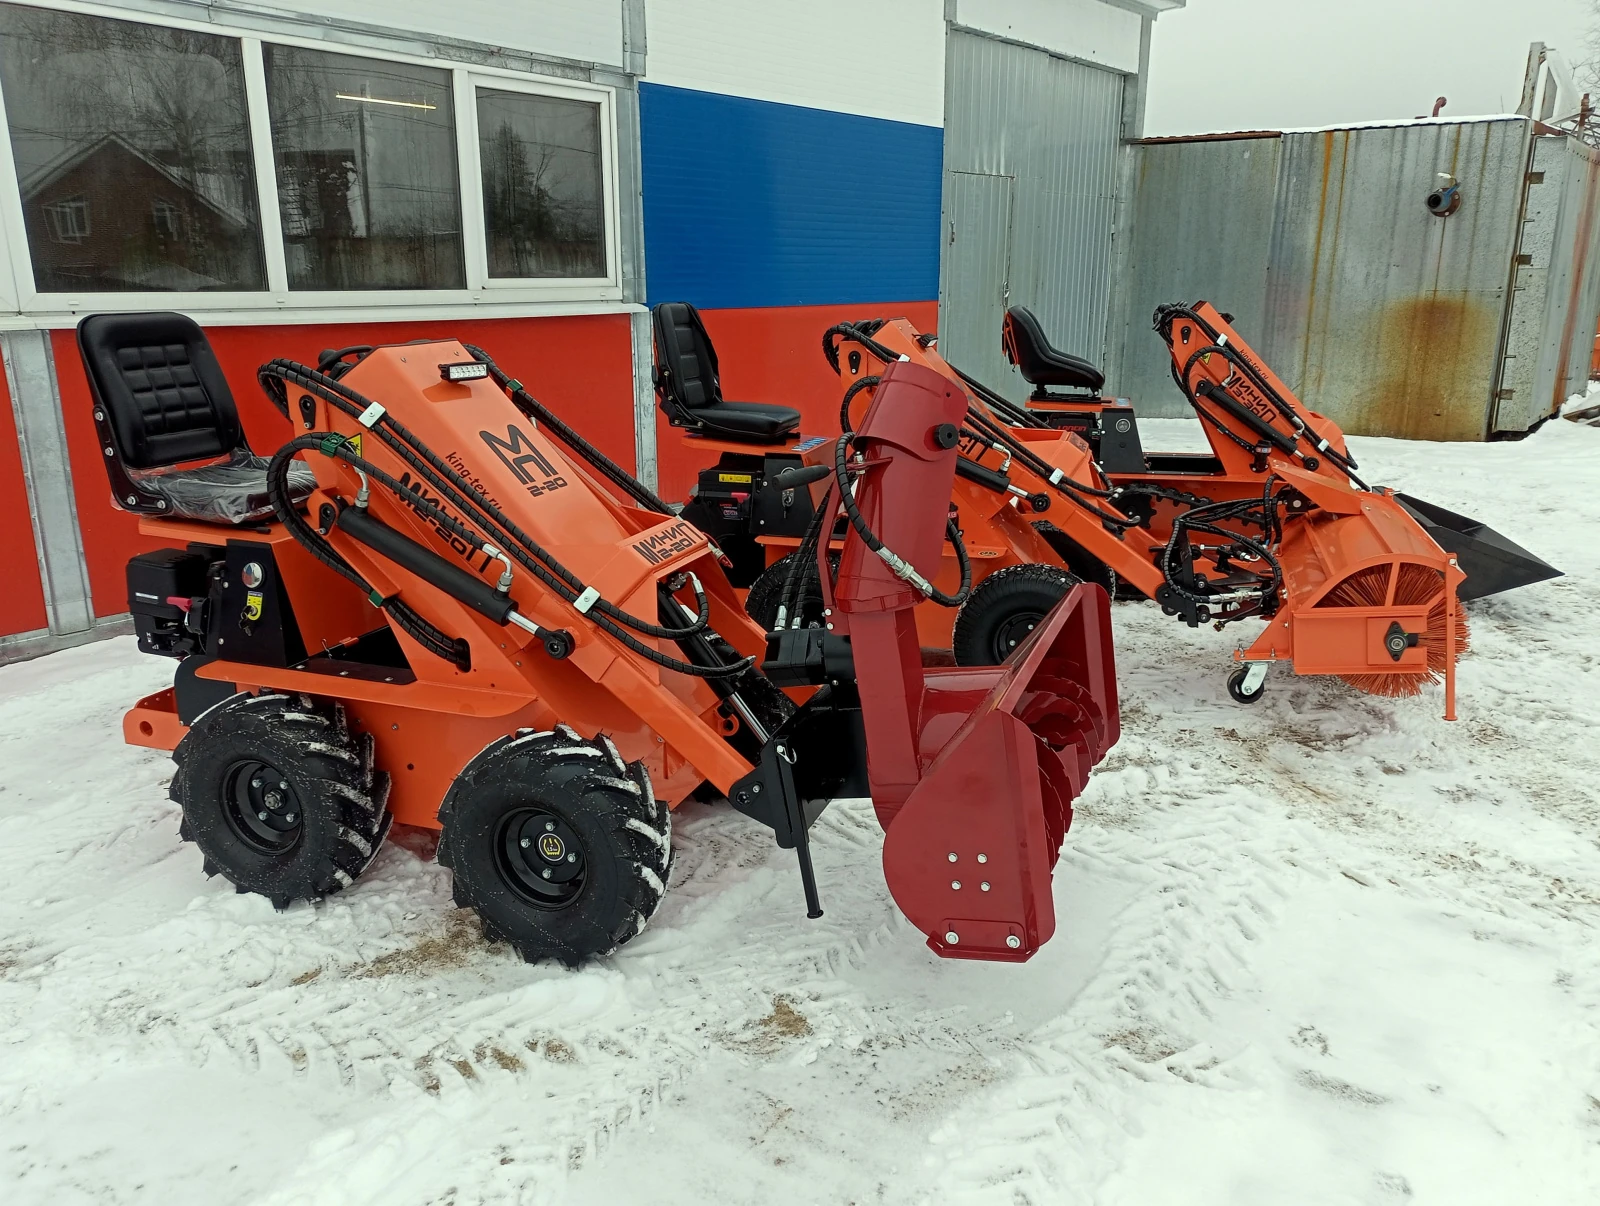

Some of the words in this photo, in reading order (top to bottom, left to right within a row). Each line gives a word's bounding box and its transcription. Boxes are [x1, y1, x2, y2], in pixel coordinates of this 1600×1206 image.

[445, 451, 503, 510] king-tex.ru
[526, 476, 568, 497] 2-20
[657, 538, 693, 560] 2-20
